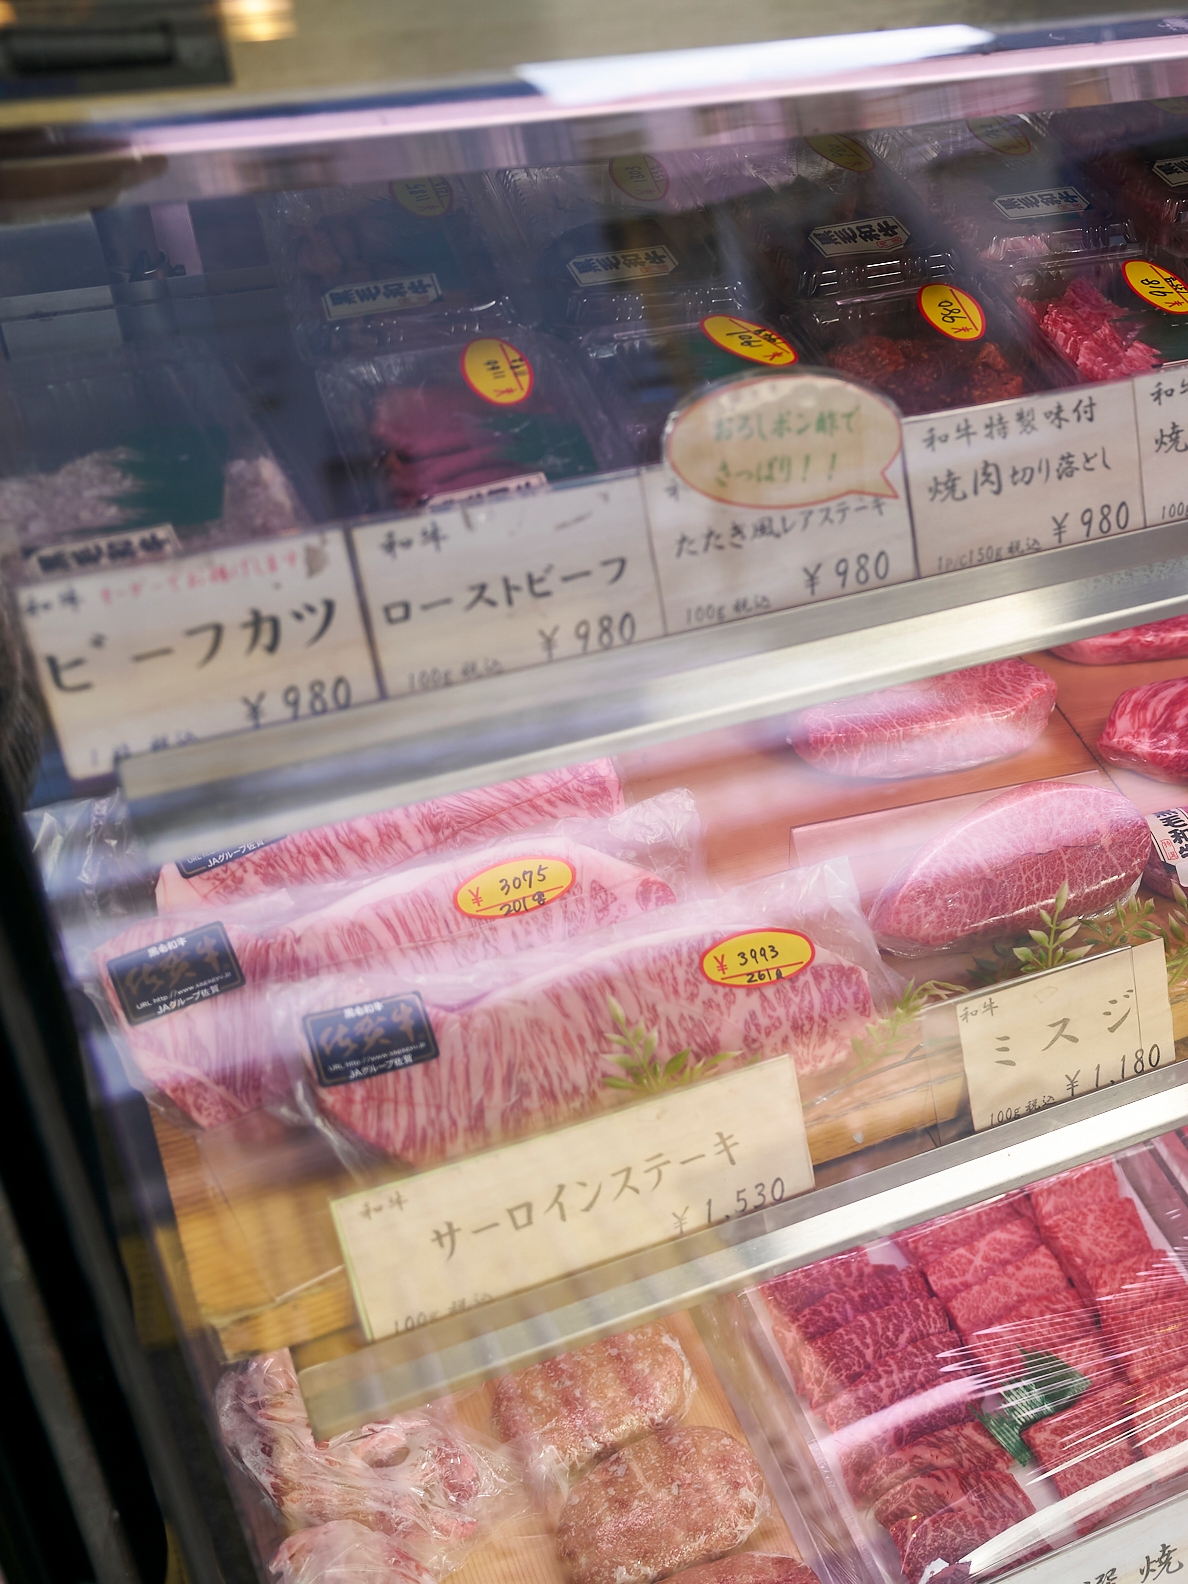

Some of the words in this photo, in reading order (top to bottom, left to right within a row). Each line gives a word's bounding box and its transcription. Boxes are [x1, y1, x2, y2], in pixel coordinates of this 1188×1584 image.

[813, 221, 898, 245] 黒毛和牛
[938, 300, 973, 333] ¥980
[1140, 278, 1185, 308] ¥918
[922, 395, 1097, 452] 和牛特製味付
[927, 447, 1111, 502] 焼肉切り落とし
[381, 521, 447, 559] 和牛
[675, 496, 886, 558] たたき風レアステーキ
[1006, 537, 1042, 555] 税込
[1052, 501, 1129, 544] ¥980
[383, 557, 627, 626] ローストビーフ
[803, 550, 889, 596] ¥980
[538, 612, 635, 661] ¥980
[686, 604, 726, 624] 100g
[45, 597, 336, 694] ビーフカツ
[241, 676, 352, 729] ¥980
[959, 997, 999, 1024] 和牛
[994, 988, 1135, 1067] ミスジ
[1064, 1043, 1161, 1097] ¥1,180
[989, 1106, 1022, 1126] 100g
[1024, 1095, 1056, 1113] 税込
[358, 1191, 408, 1221] 和牛
[429, 1130, 741, 1262] サーロインステーキ
[672, 1176, 787, 1235] ¥1,530
